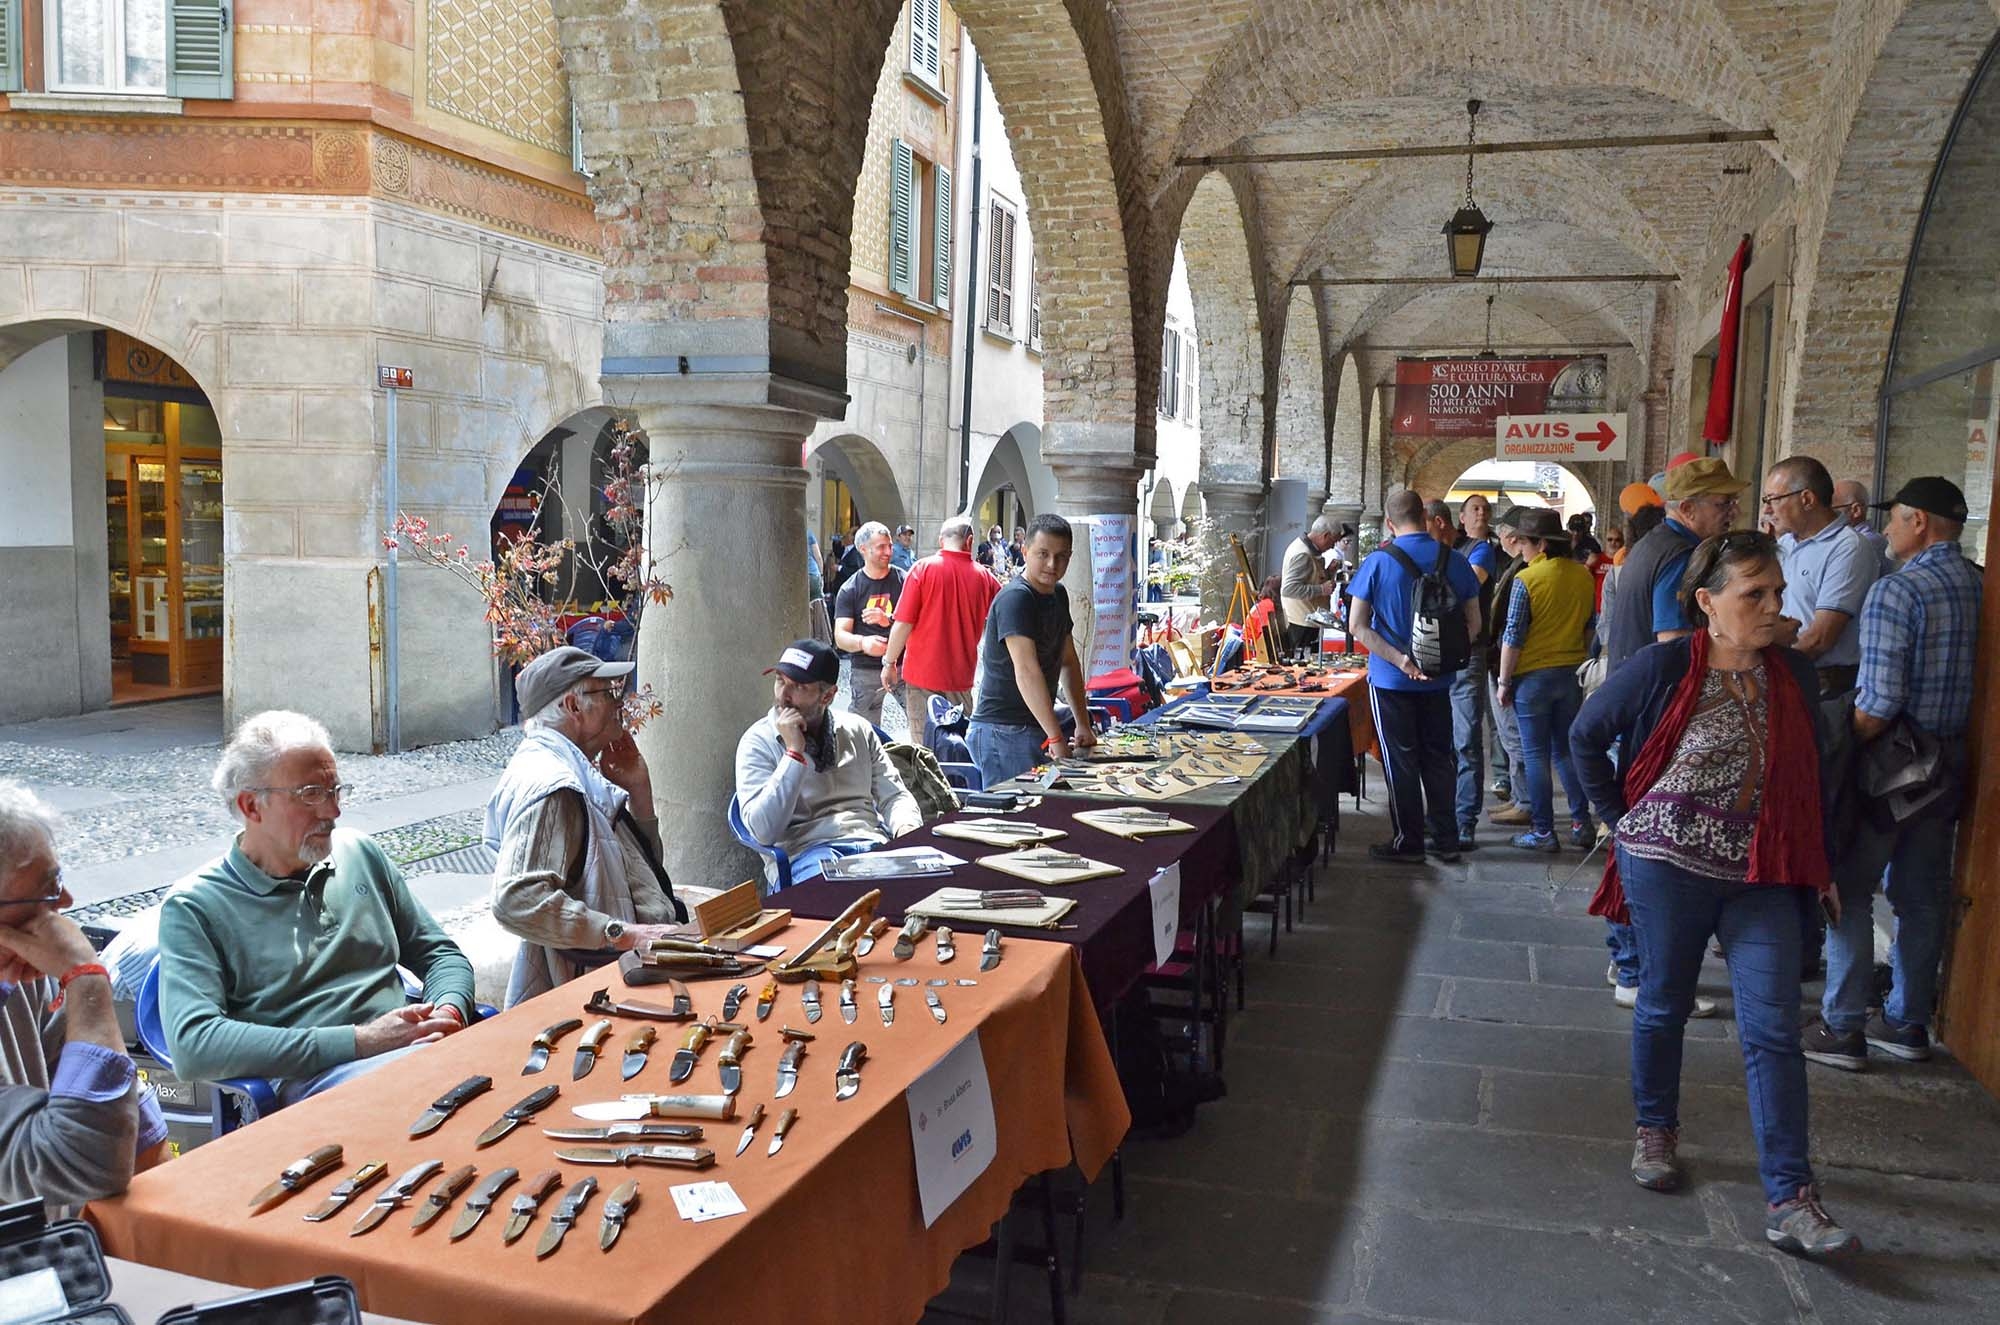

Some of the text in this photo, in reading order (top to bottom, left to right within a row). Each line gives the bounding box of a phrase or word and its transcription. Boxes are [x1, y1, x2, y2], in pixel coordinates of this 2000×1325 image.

[1450, 363, 1527, 373] MUSEO D'ARTE
[1450, 372, 1545, 381] E CULTURA SACRA
[1429, 383, 1514, 399] 500 ANNI
[1429, 398, 1497, 406] DI ARTE SACRA
[1429, 406, 1481, 414] IN MOSTRA
[1505, 422, 1570, 439] AVIS
[1504, 442, 1575, 456] ORGANIZZAZIONE
[951, 1128, 972, 1158] AVIS
